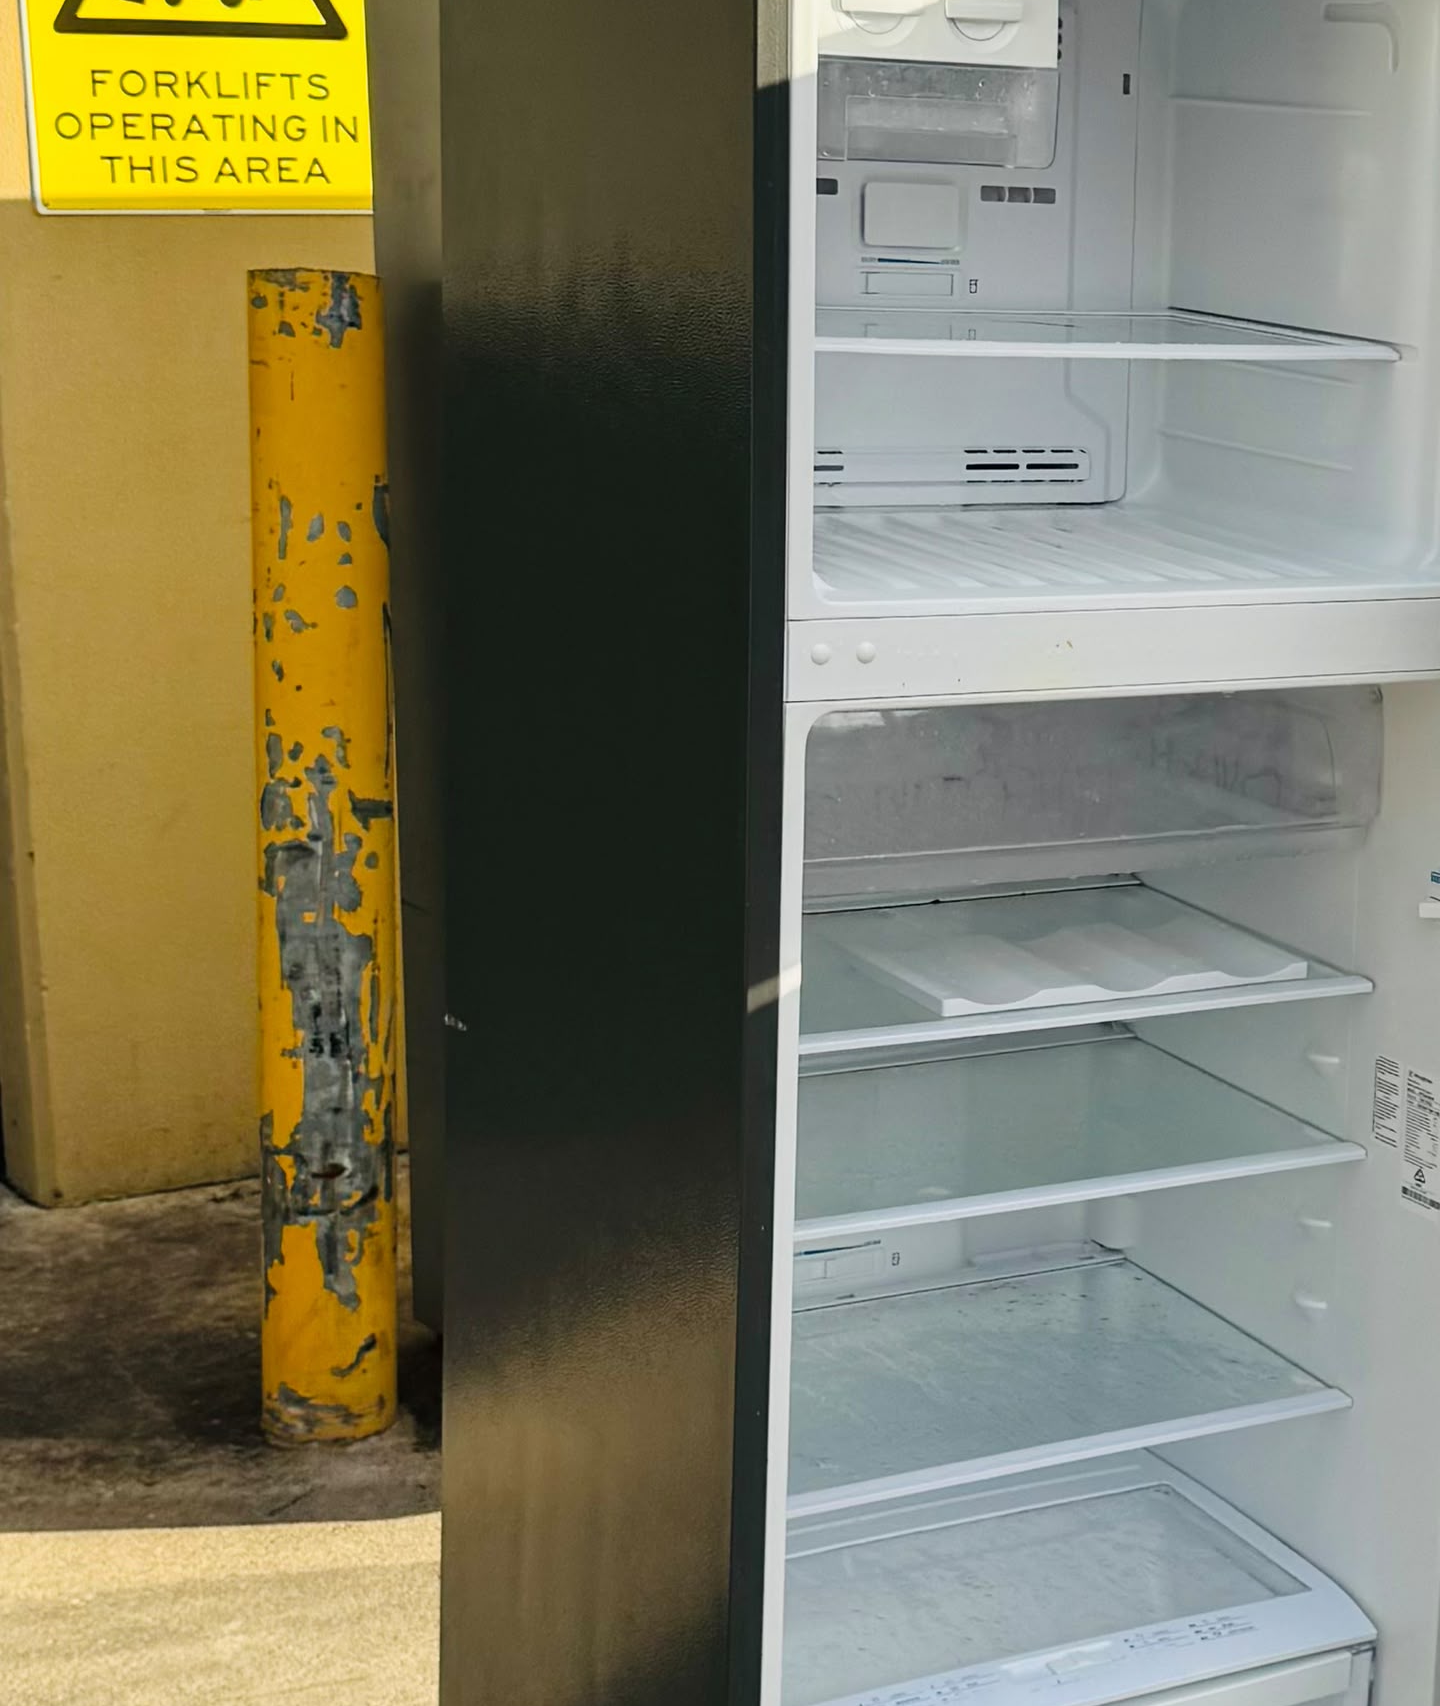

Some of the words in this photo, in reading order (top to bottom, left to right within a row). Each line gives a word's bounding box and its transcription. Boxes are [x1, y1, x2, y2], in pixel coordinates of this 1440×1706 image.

[90, 69, 330, 101] FORKLIFTS
[54, 112, 308, 142] OPERATING
[321, 114, 359, 143] IN
[99, 155, 199, 184] THIS
[213, 156, 332, 184] AREA
